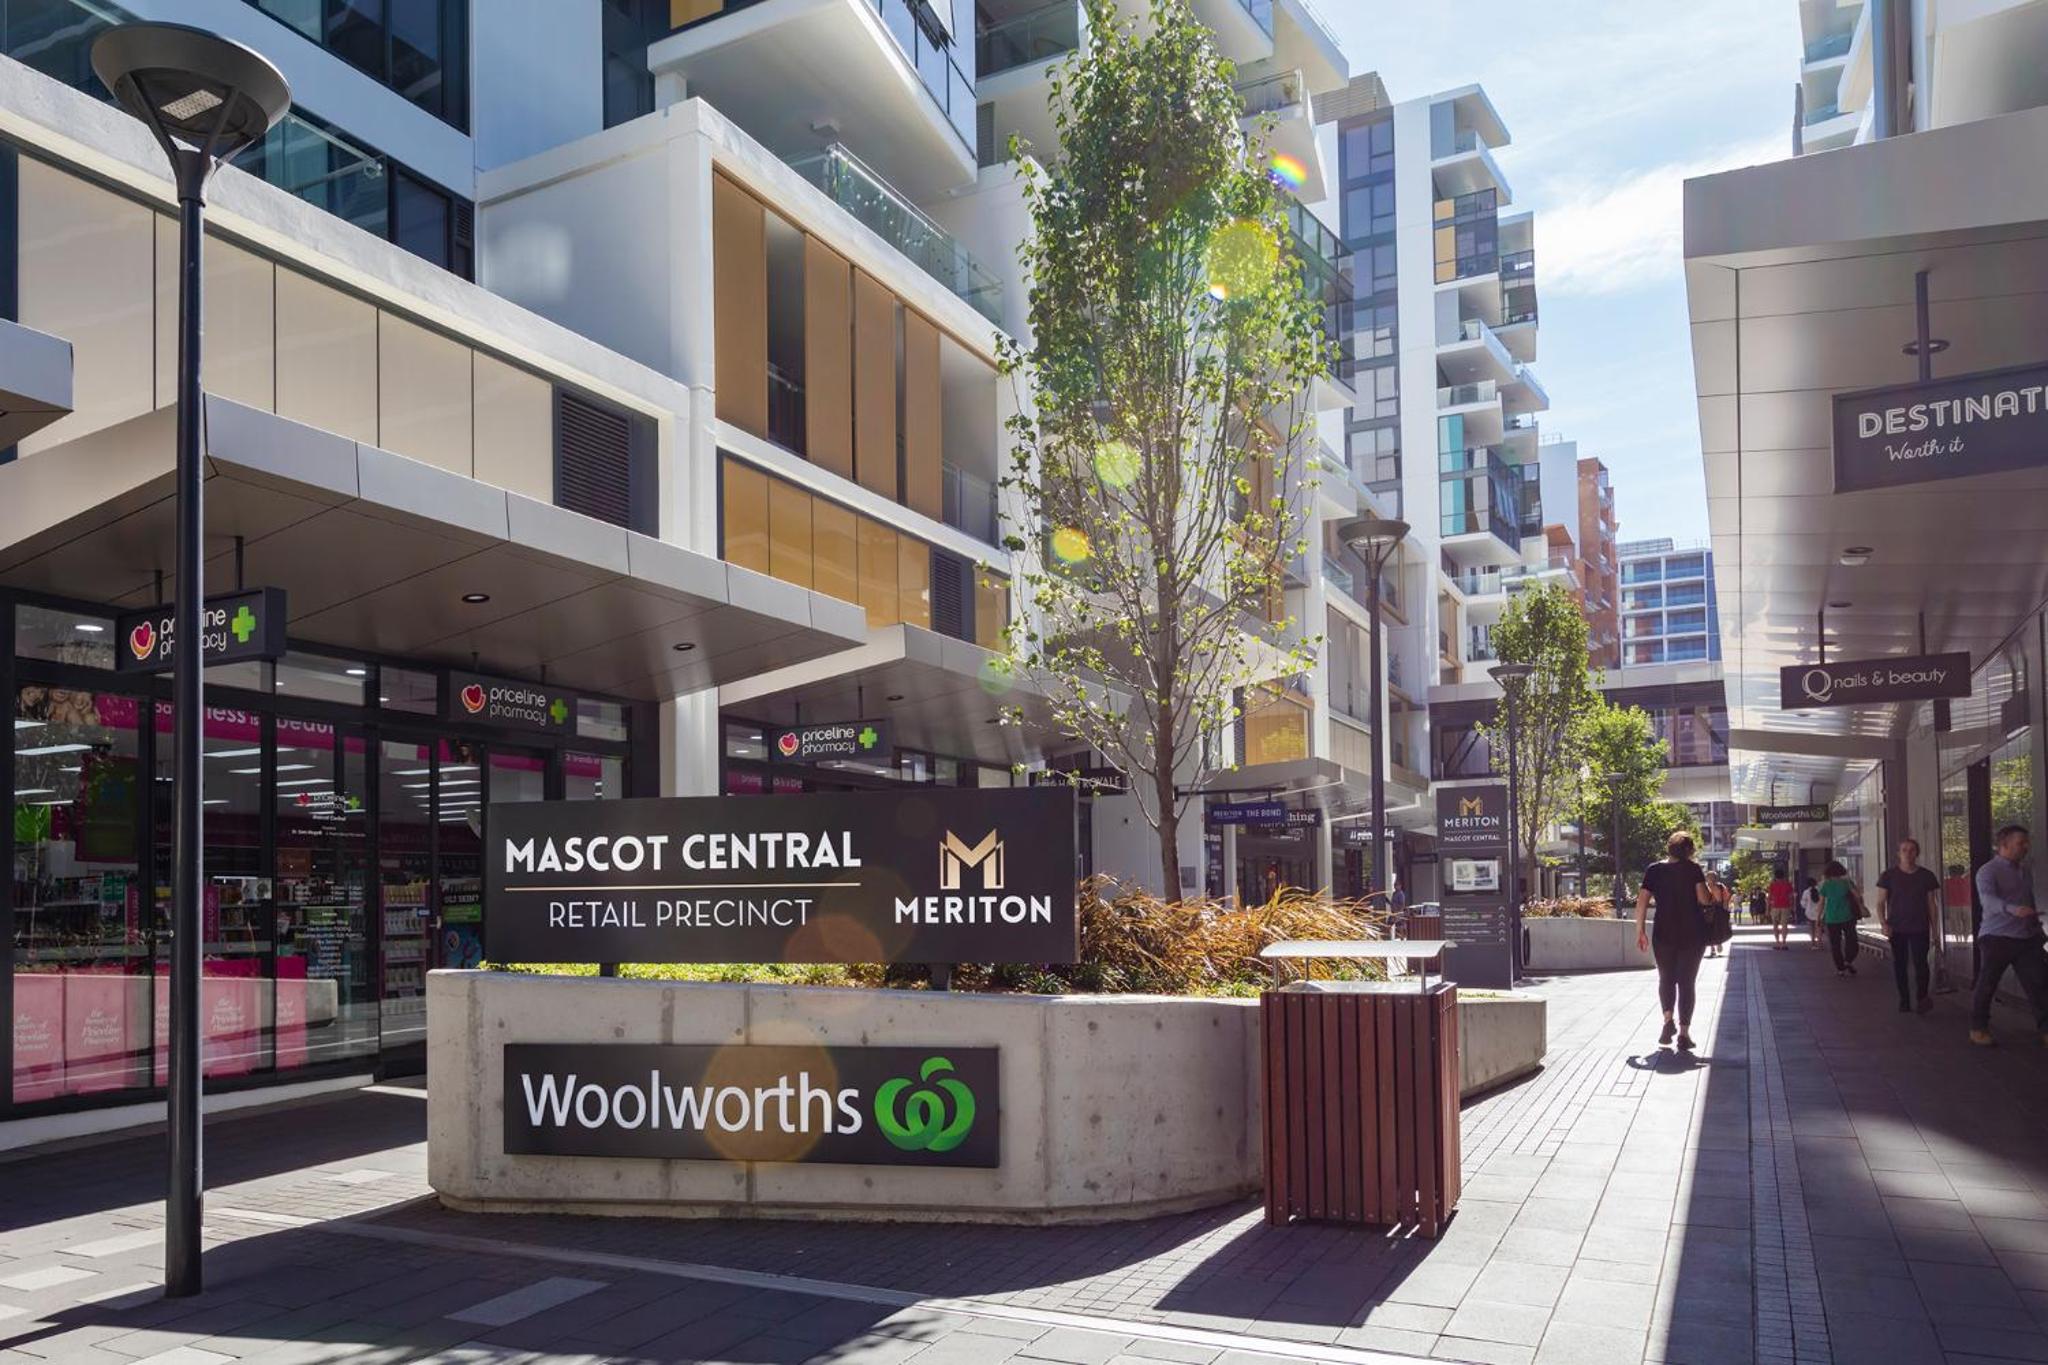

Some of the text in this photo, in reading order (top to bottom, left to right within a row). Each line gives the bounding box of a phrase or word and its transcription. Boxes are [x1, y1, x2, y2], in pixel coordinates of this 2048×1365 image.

[1858, 385, 2048, 439] DESTINAT
[1885, 436, 1965, 462] Worth it
[160, 609, 227, 640] prine
[160, 631, 227, 660] phacy
[1872, 671, 1885, 686] &
[1889, 668, 1947, 686] beauty
[489, 687, 547, 708] priceline
[489, 702, 547, 726] pharmacy
[802, 726, 856, 745] priceline
[802, 741, 856, 757] pharmacy
[1246, 809, 1260, 818] THE
[1260, 807, 1282, 817] BOND
[1444, 816, 1500, 828] MERITON
[1760, 810, 1810, 820] Woolworths
[505, 831, 862, 872] MASCOT CENTRAL
[549, 899, 813, 928] RETAIL PRECINCT
[894, 895, 1052, 925] MERITON
[521, 1069, 864, 1135] Woolworths
